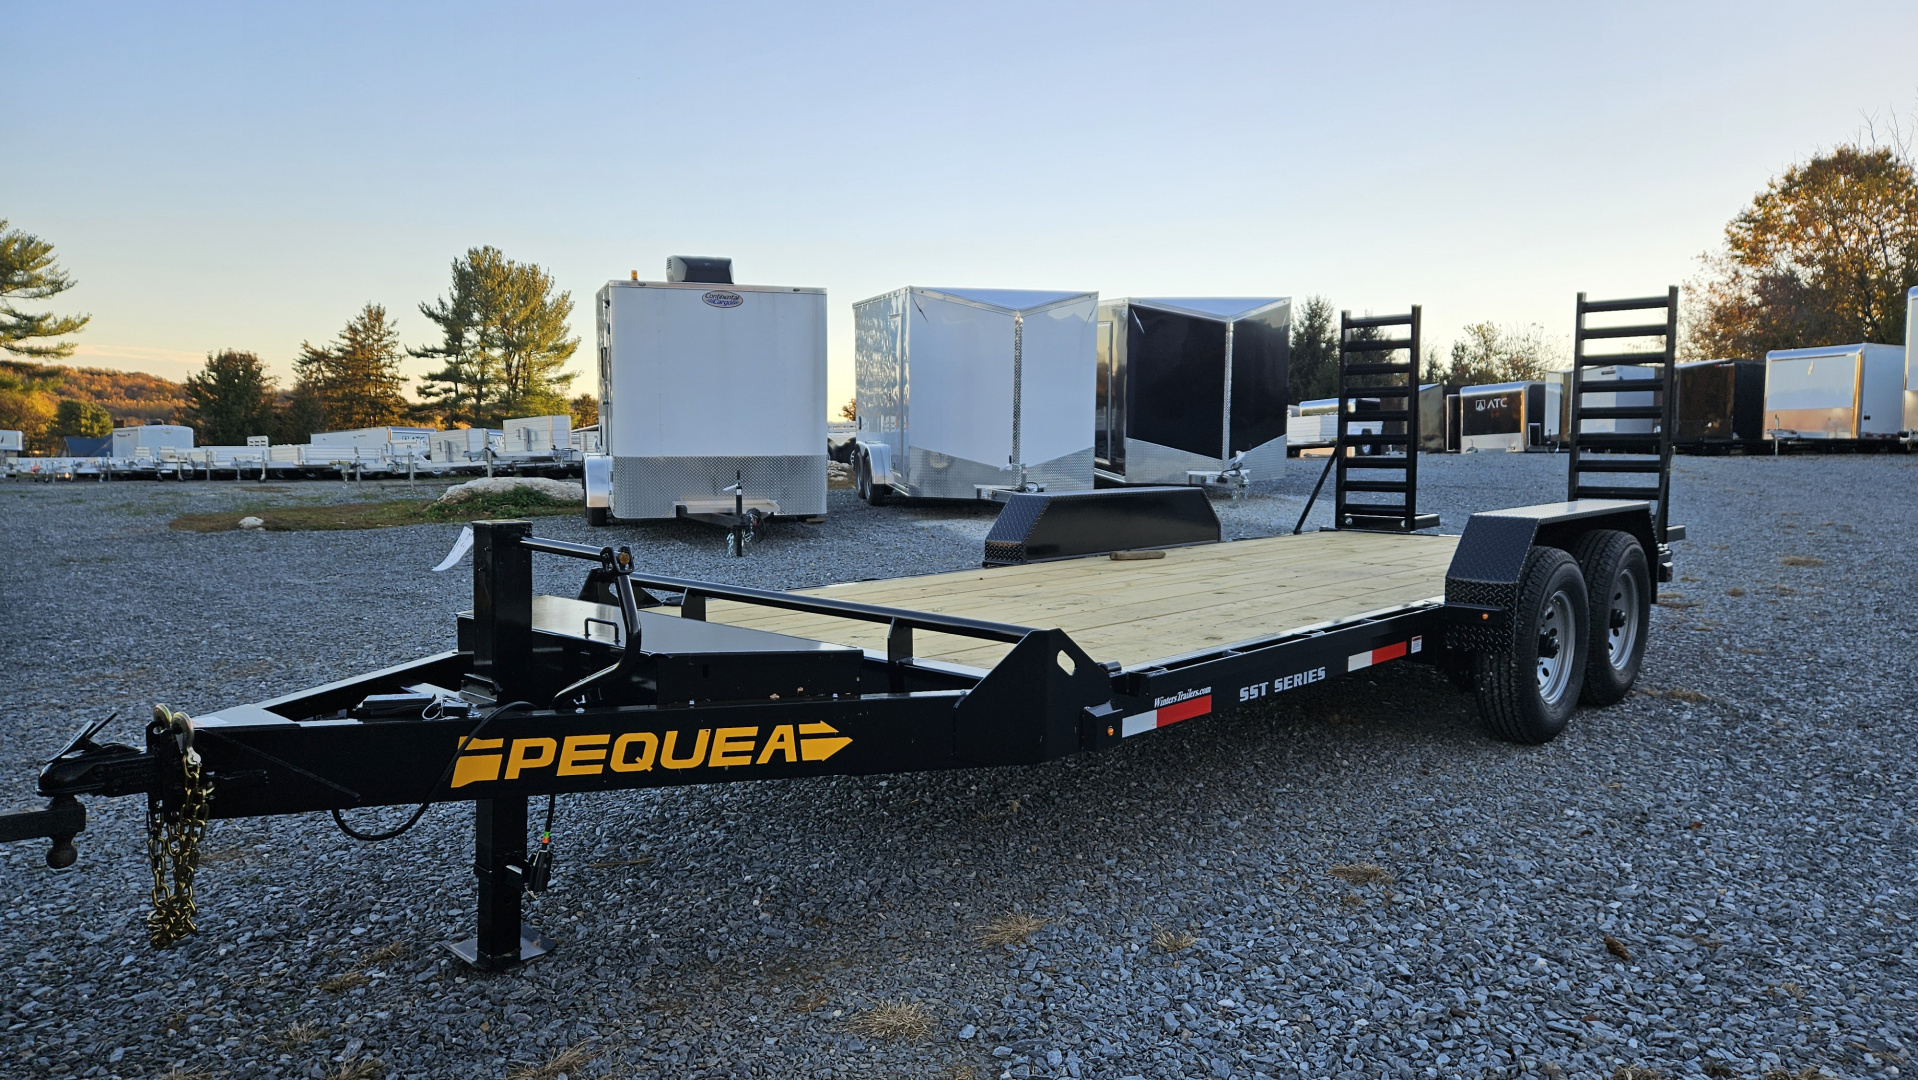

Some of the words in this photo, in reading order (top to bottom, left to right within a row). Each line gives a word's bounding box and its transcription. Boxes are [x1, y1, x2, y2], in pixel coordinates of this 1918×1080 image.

[704, 292, 741, 301] Continental
[1487, 397, 1508, 409] ATC
[1239, 681, 1269, 702] SST
[1274, 666, 1326, 693] SERIES
[503, 724, 798, 780] PEQUEA
